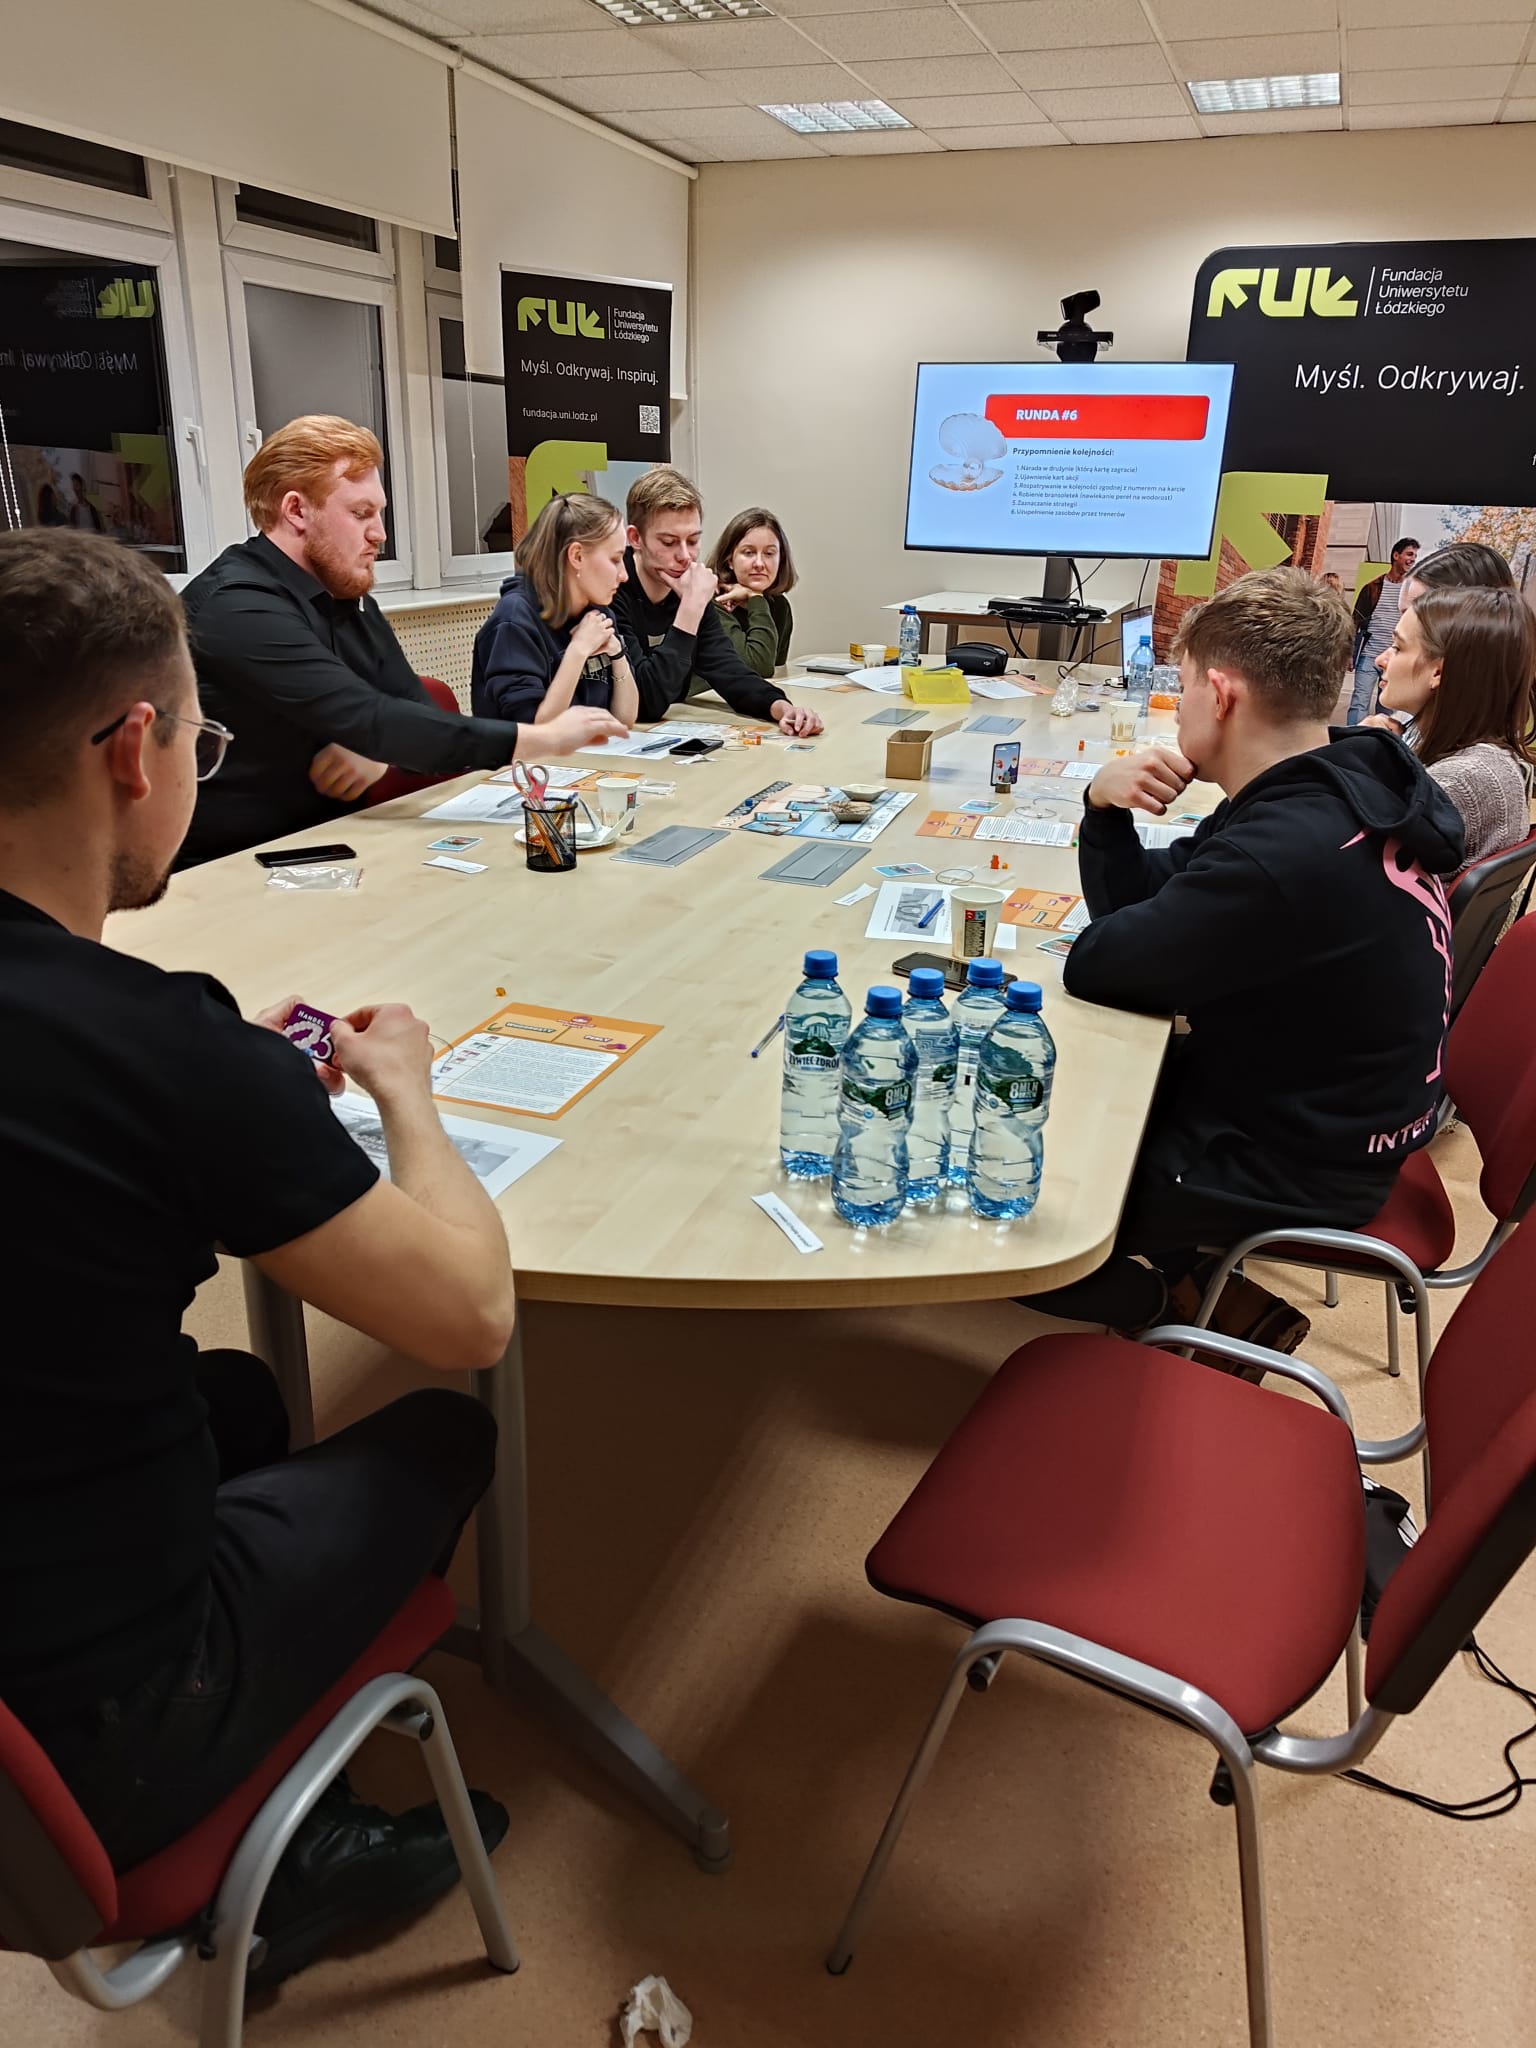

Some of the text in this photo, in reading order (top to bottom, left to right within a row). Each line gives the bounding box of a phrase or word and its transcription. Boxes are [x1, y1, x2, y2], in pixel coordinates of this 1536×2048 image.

[1381, 268, 1443, 284] Fundacja
[1378, 284, 1469, 300] Uniwersytetu
[613, 307, 645, 322] Fundacja
[1375, 301, 1446, 317] Łódzkiego
[613, 319, 659, 333] Uniwersytetu
[614, 330, 650, 343] Łódzkiego
[521, 359, 659, 386] Myśl. Odkrywaj. Inspiruj.
[1294, 362, 1526, 396] Myśl. Odkrywaj.
[522, 407, 598, 422] fundacja.uni.lodz.pl
[1016, 409, 1078, 420] RUNDA #6
[1012, 447, 1115, 457] Przypomnienie kolejności:
[297, 1010, 326, 1028] HANDEL
[884, 1088, 894, 1107] 8
[1009, 1081, 1020, 1099] 8
